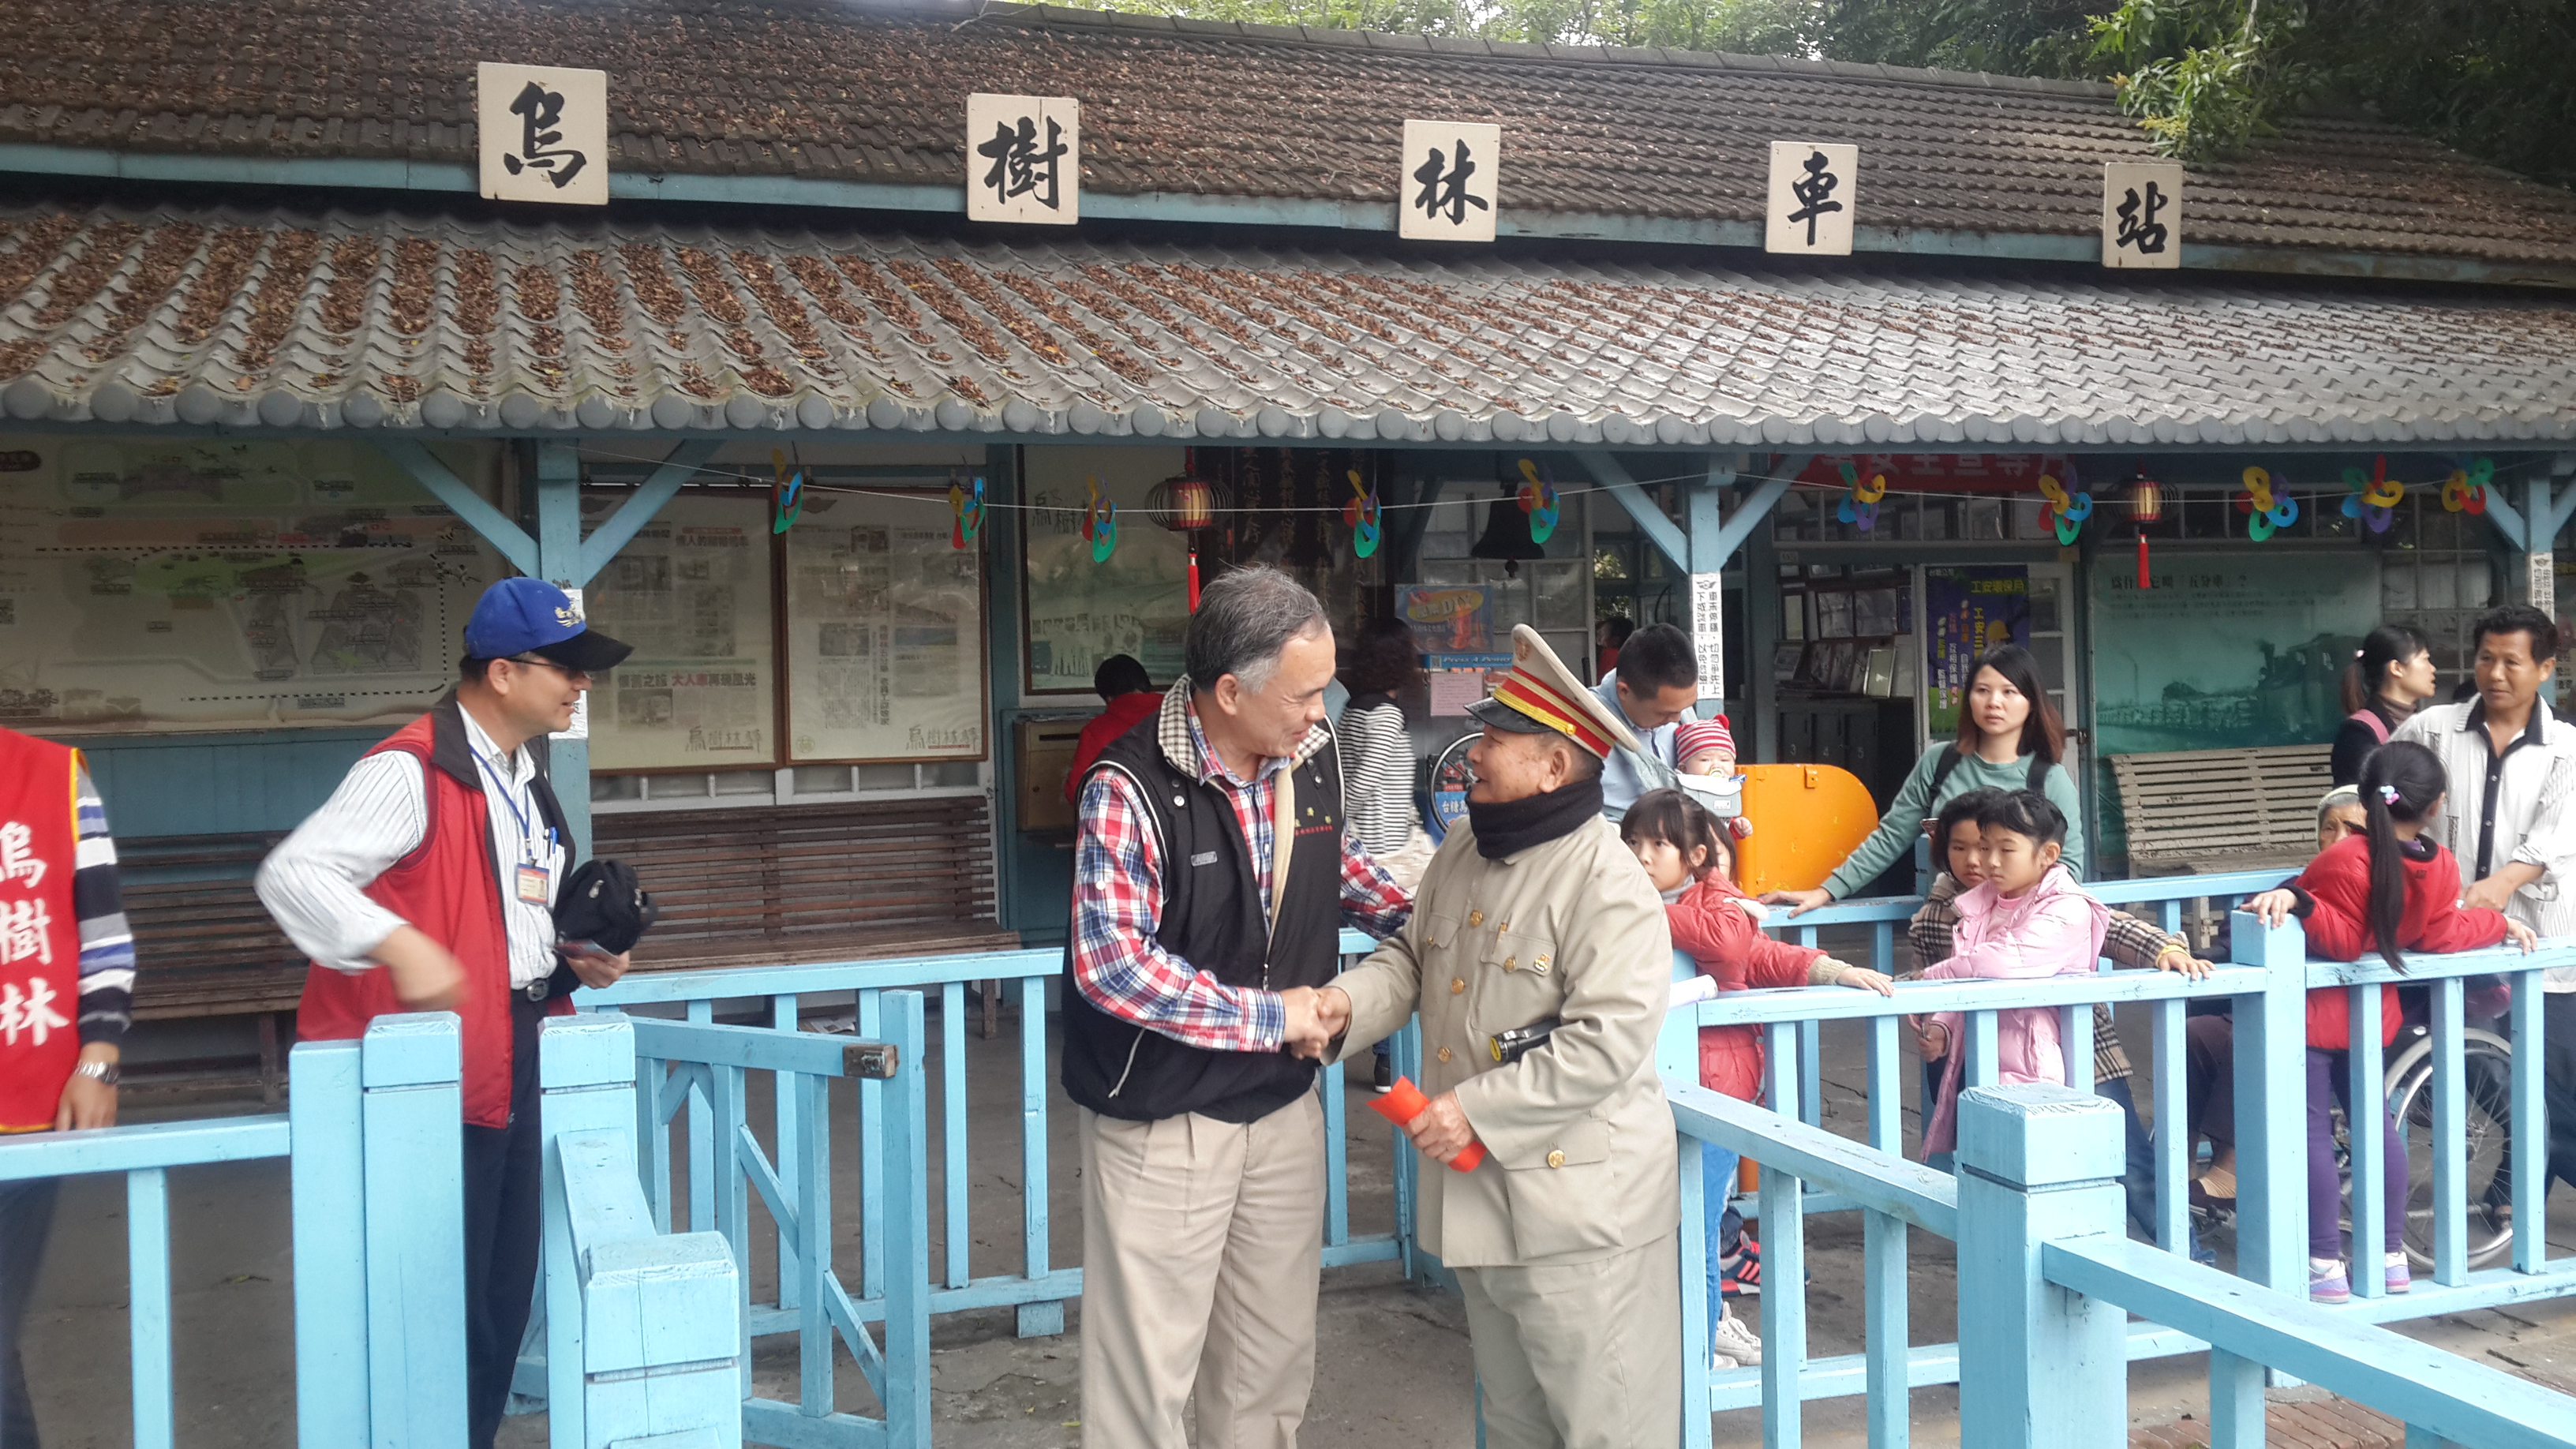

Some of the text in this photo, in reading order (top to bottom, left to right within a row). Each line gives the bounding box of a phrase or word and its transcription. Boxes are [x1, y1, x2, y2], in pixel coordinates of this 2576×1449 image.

[504, 80, 2169, 255] 烏 樹 林 車 站
